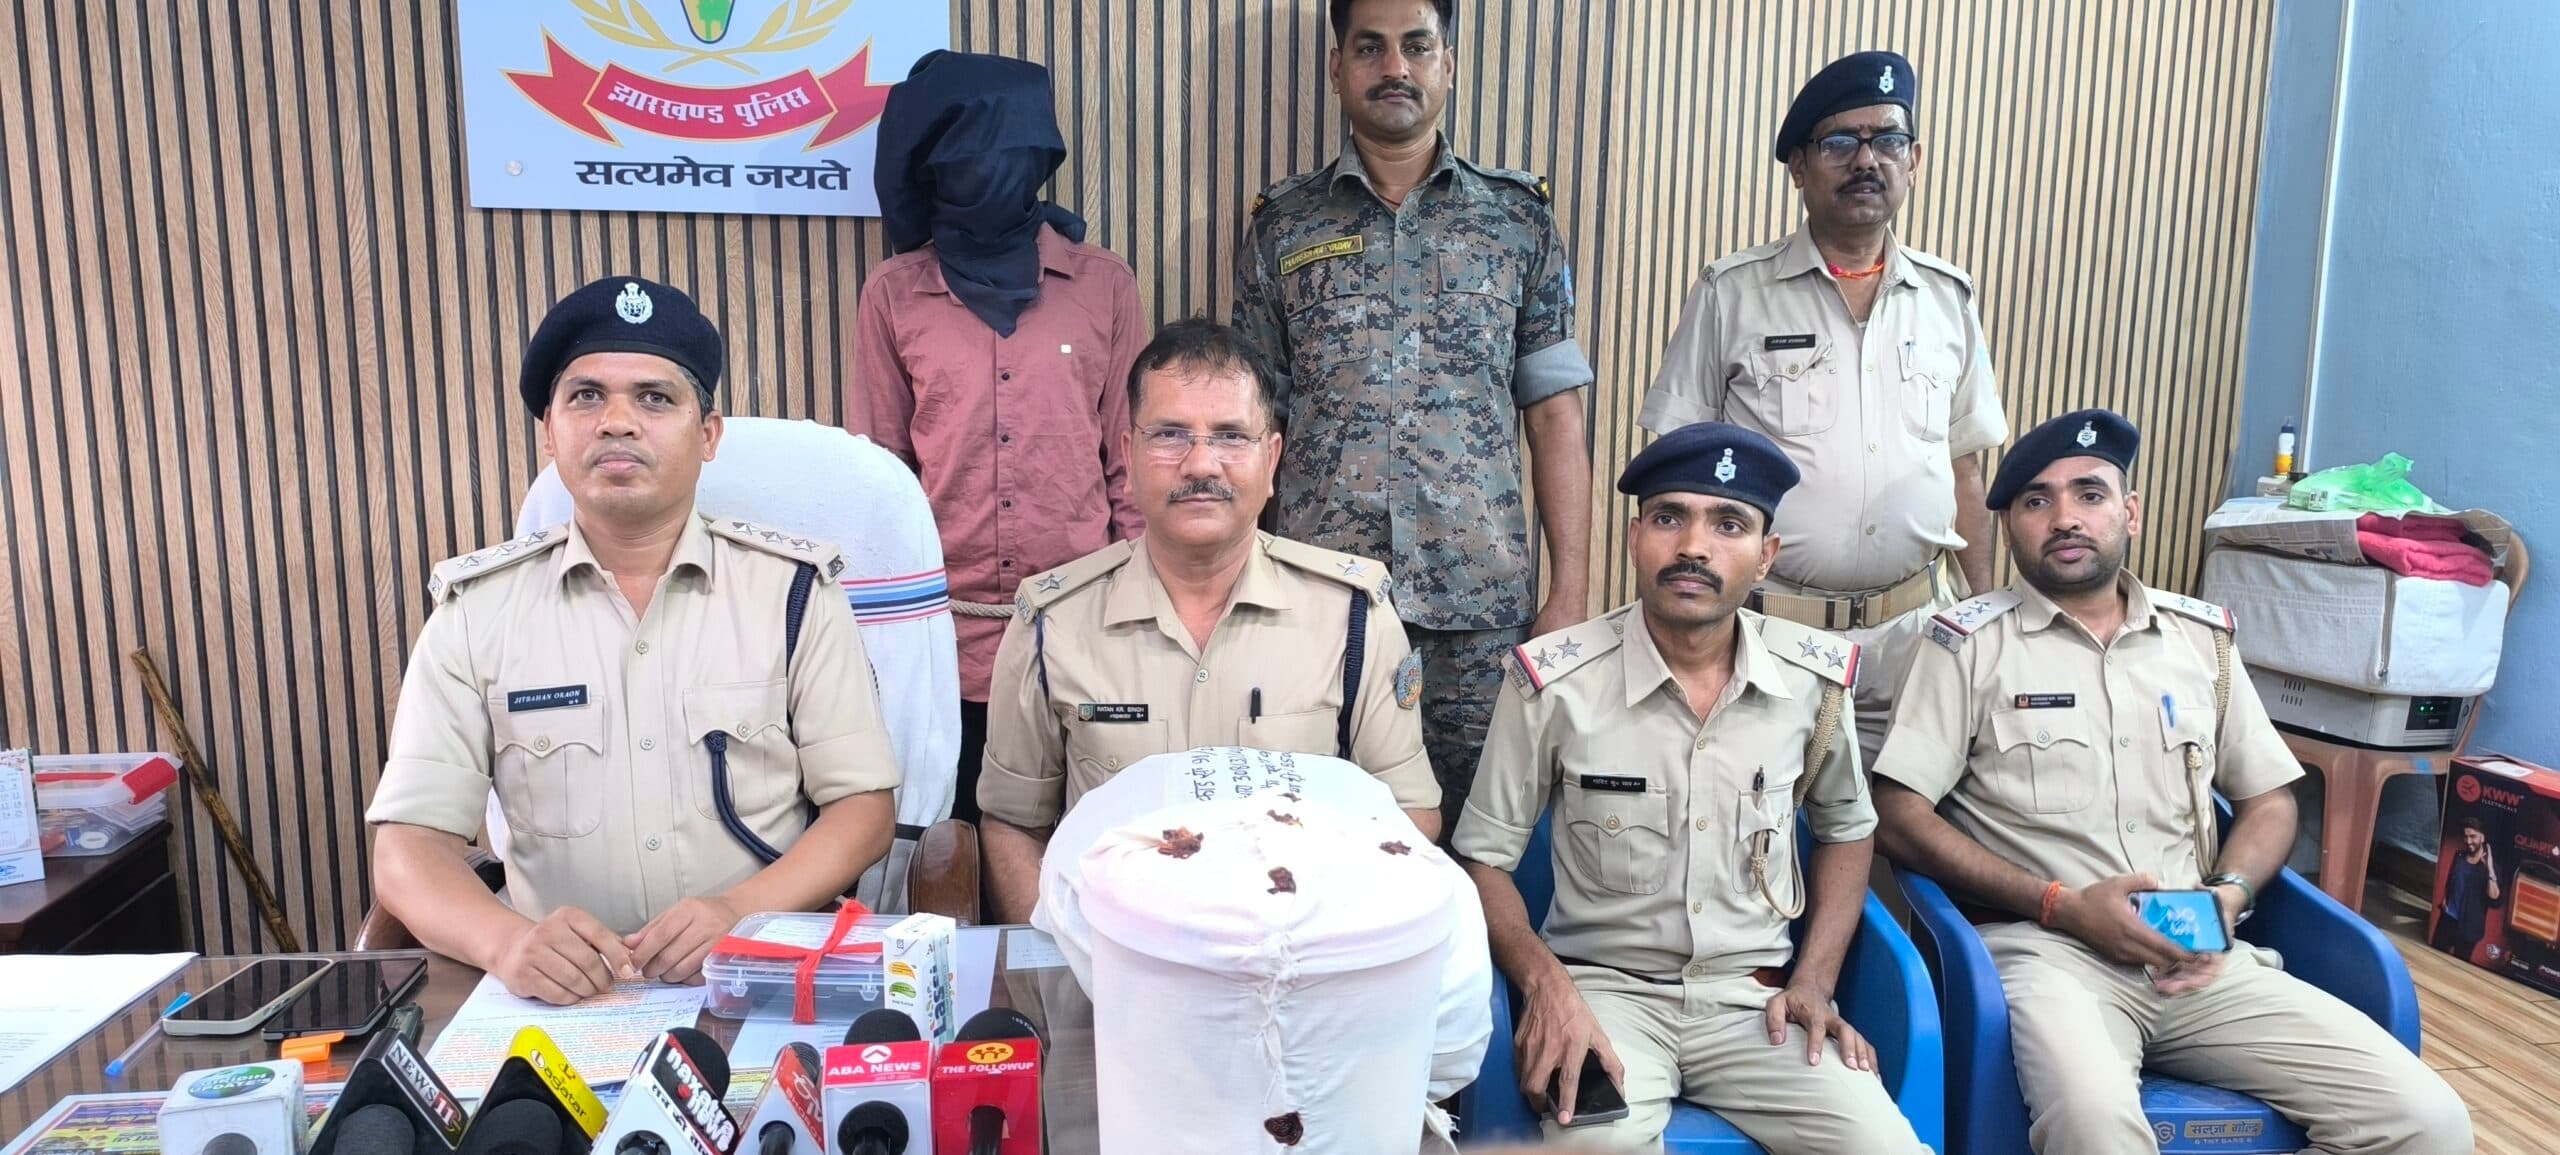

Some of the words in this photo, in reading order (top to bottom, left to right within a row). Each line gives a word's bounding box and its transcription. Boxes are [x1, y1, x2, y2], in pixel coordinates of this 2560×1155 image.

[608, 81, 725, 124] झारखण्ड
[734, 86, 811, 127] पुलिस
[574, 155, 735, 188] सत्यमेव
[745, 159, 851, 191] जयते
[2481, 785, 2520, 807] KWW
[828, 1065, 864, 1076] ABA
[870, 1062, 922, 1073] NEWS
[942, 1065, 966, 1074] THE
[969, 1062, 1035, 1073] FOLLOWUP
